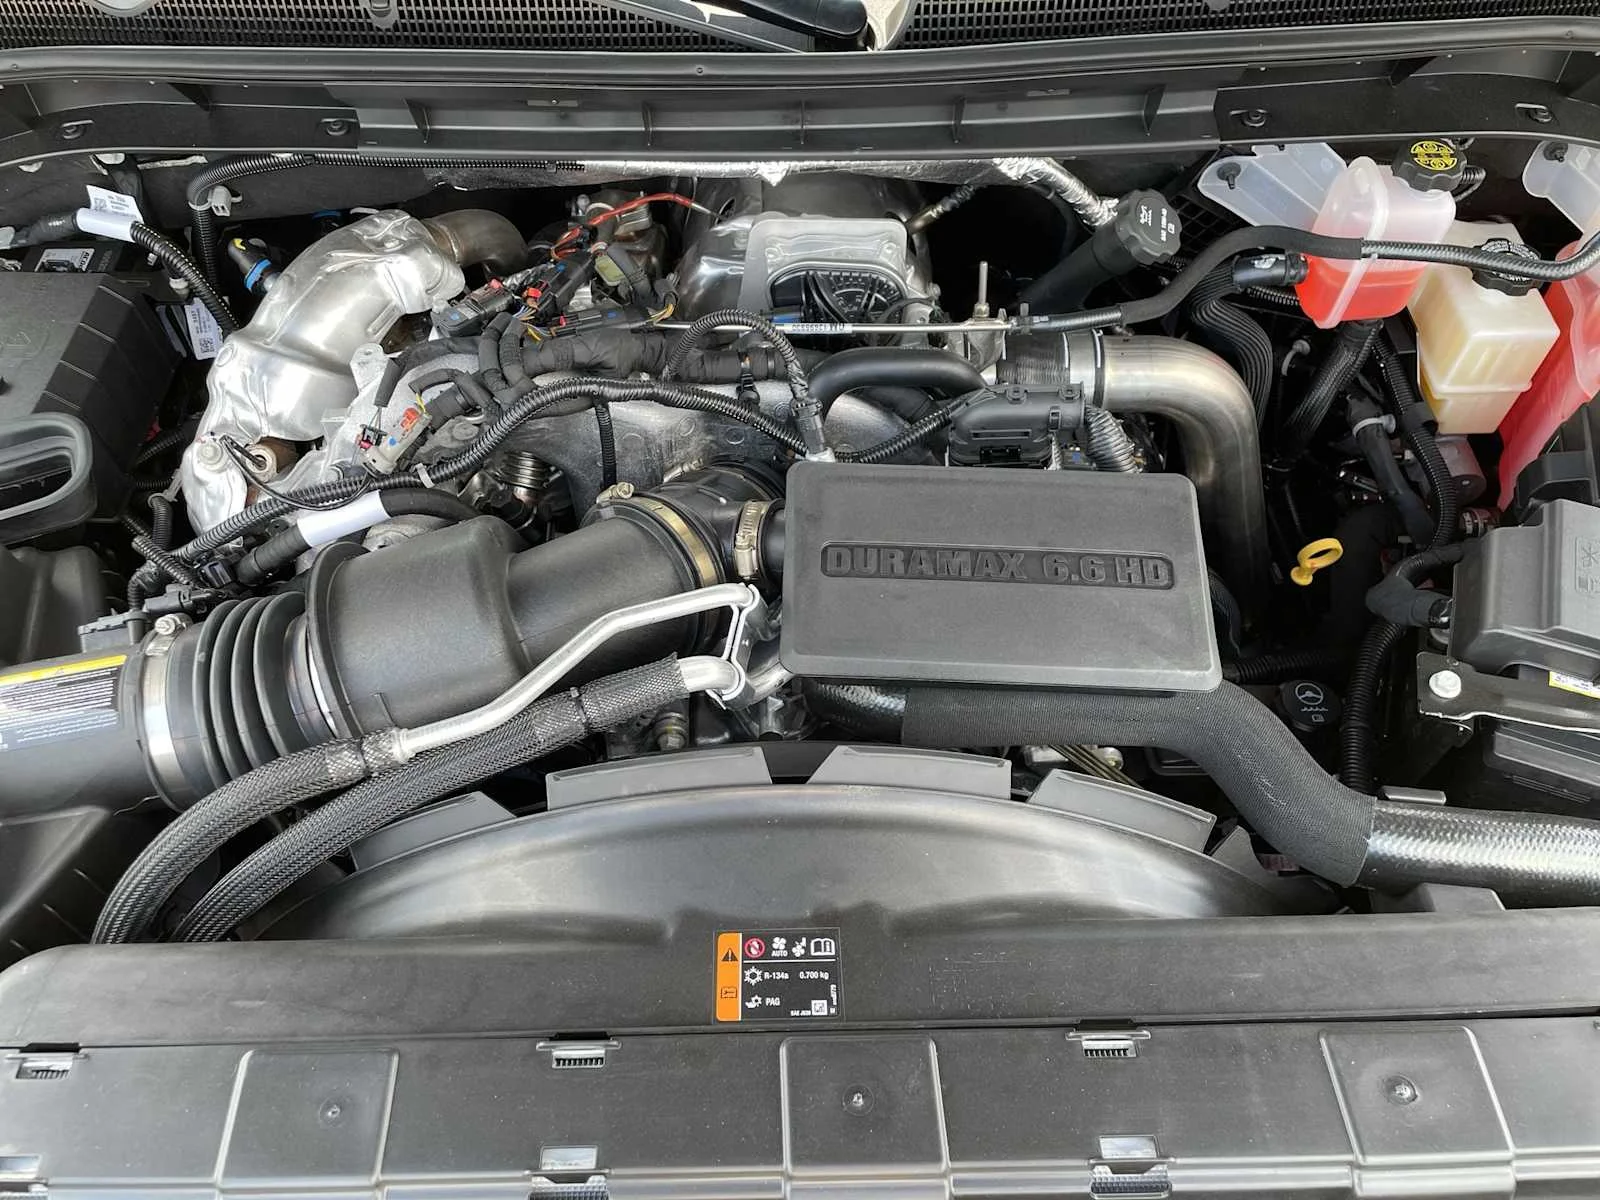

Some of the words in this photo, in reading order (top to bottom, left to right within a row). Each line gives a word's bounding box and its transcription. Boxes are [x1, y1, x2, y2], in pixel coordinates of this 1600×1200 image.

[826, 546, 1027, 580] DURAMAX
[1042, 553, 1104, 583] 6.6
[1115, 556, 1170, 586] HD
[764, 972, 789, 980] R-134a
[819, 972, 829, 981] kg
[765, 997, 780, 1006] PAG
